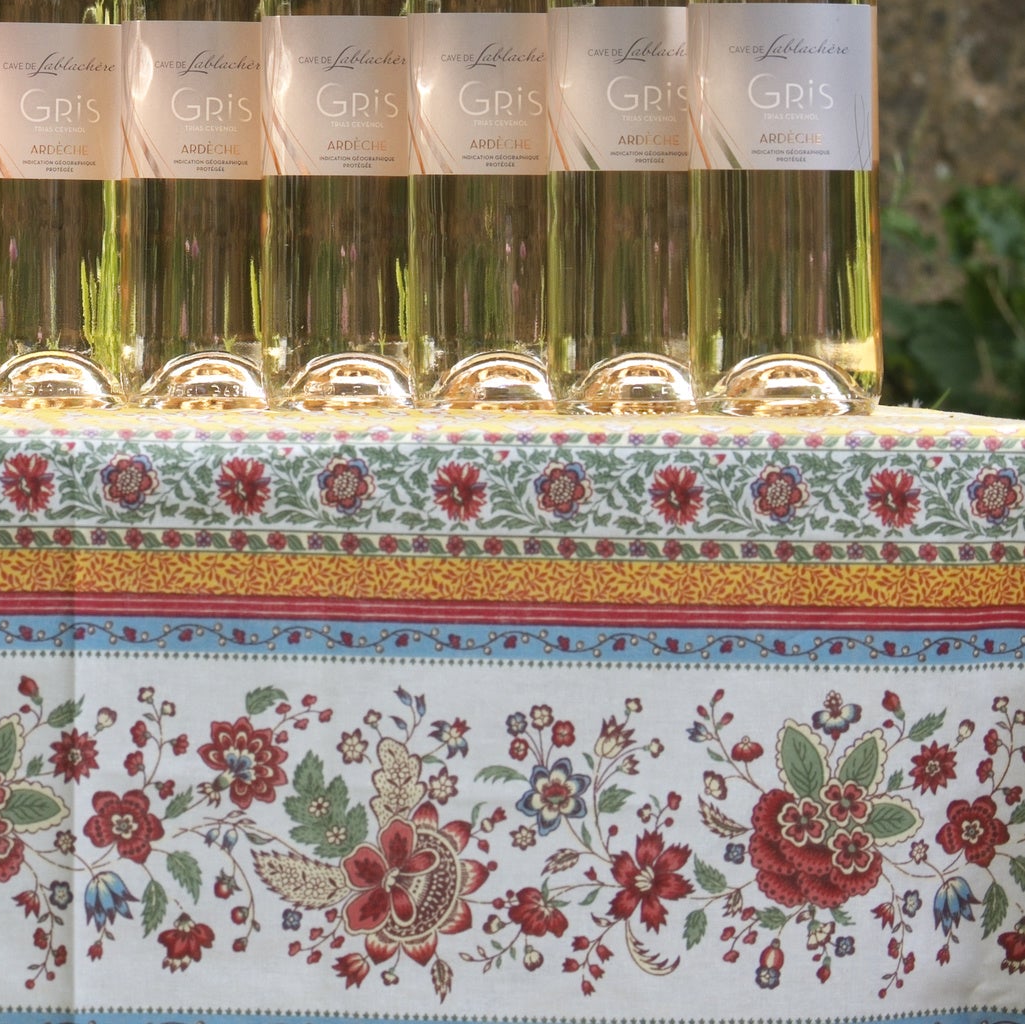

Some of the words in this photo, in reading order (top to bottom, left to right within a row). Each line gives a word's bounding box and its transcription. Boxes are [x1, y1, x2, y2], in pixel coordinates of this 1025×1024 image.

[612, 36, 687, 64] Lablach
[728, 45, 750, 54] CAVE
[753, 45, 764, 54] DE
[754, 33, 849, 62] Lablachère
[465, 42, 544, 70] Lablachè
[587, 48, 609, 56] CAVE
[611, 48, 623, 56] DE
[298, 56, 318, 64] CAVE
[321, 56, 332, 64] DE
[322, 45, 408, 72] Lablachèr
[440, 54, 461, 62] CAVE
[463, 54, 474, 62] DE
[3, 62, 23, 70] CAVE
[25, 62, 36, 70] DE
[26, 51, 116, 78] Lablachère
[155, 61, 174, 69] CAVE
[176, 61, 186, 69] DE
[177, 49, 262, 77] Lablachèr
